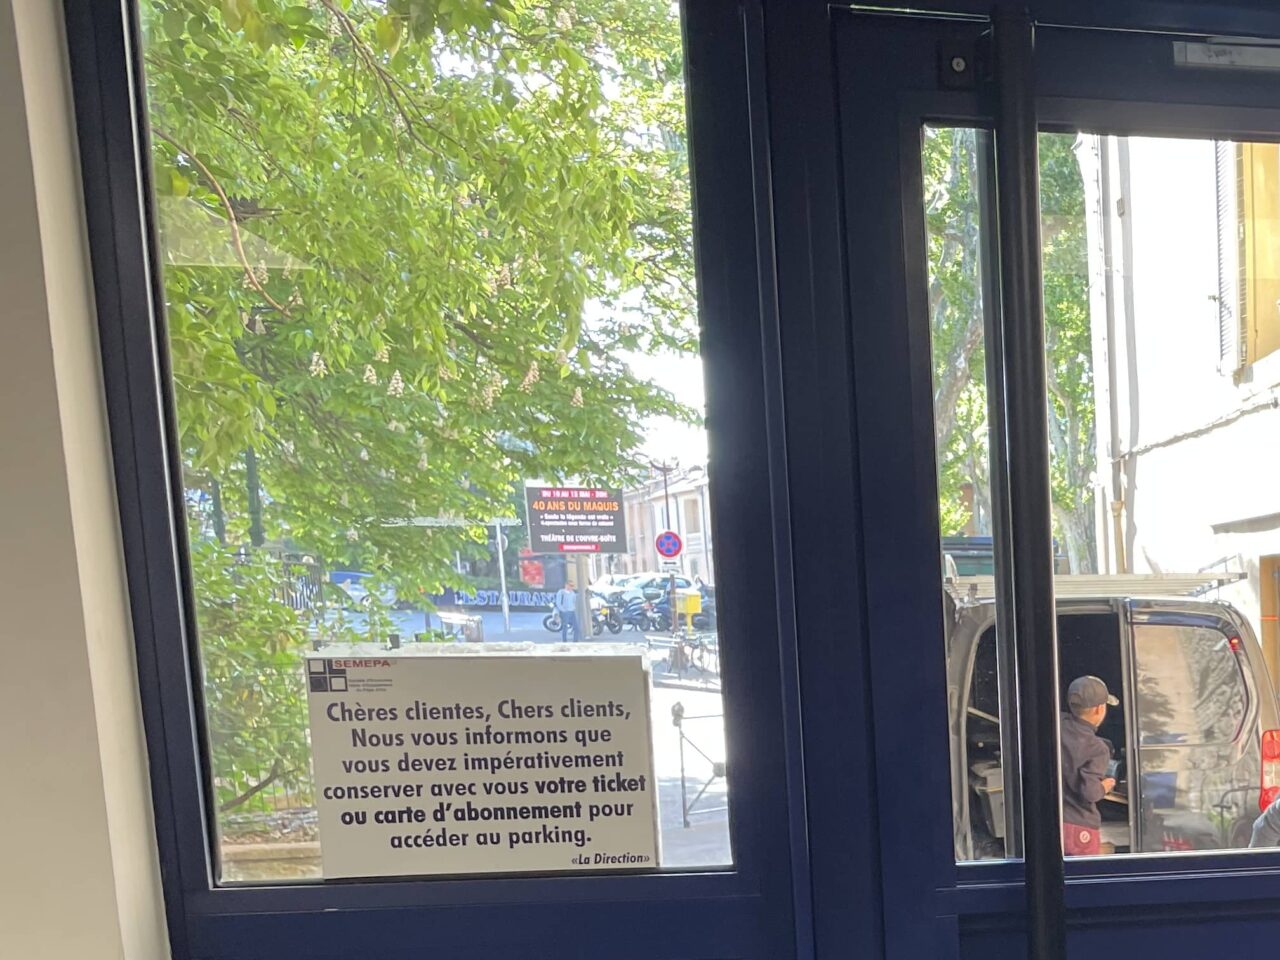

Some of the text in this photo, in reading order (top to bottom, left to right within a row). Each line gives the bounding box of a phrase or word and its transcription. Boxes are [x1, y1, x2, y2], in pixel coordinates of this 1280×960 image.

[532, 501, 619, 511] 40 ANS DU MAQUIS
[334, 659, 391, 669] SEMEPA
[326, 696, 631, 723] Chères clientes, Chers clients,
[351, 724, 612, 748] Nous vous informons que
[342, 750, 624, 774] vous devez impérativement
[323, 773, 646, 800] conserver avec vous votre ticket
[341, 801, 634, 826] ou carte d'abonnement pour
[390, 824, 592, 849] accéder au parking.
[594, 852, 650, 866] Direction»
